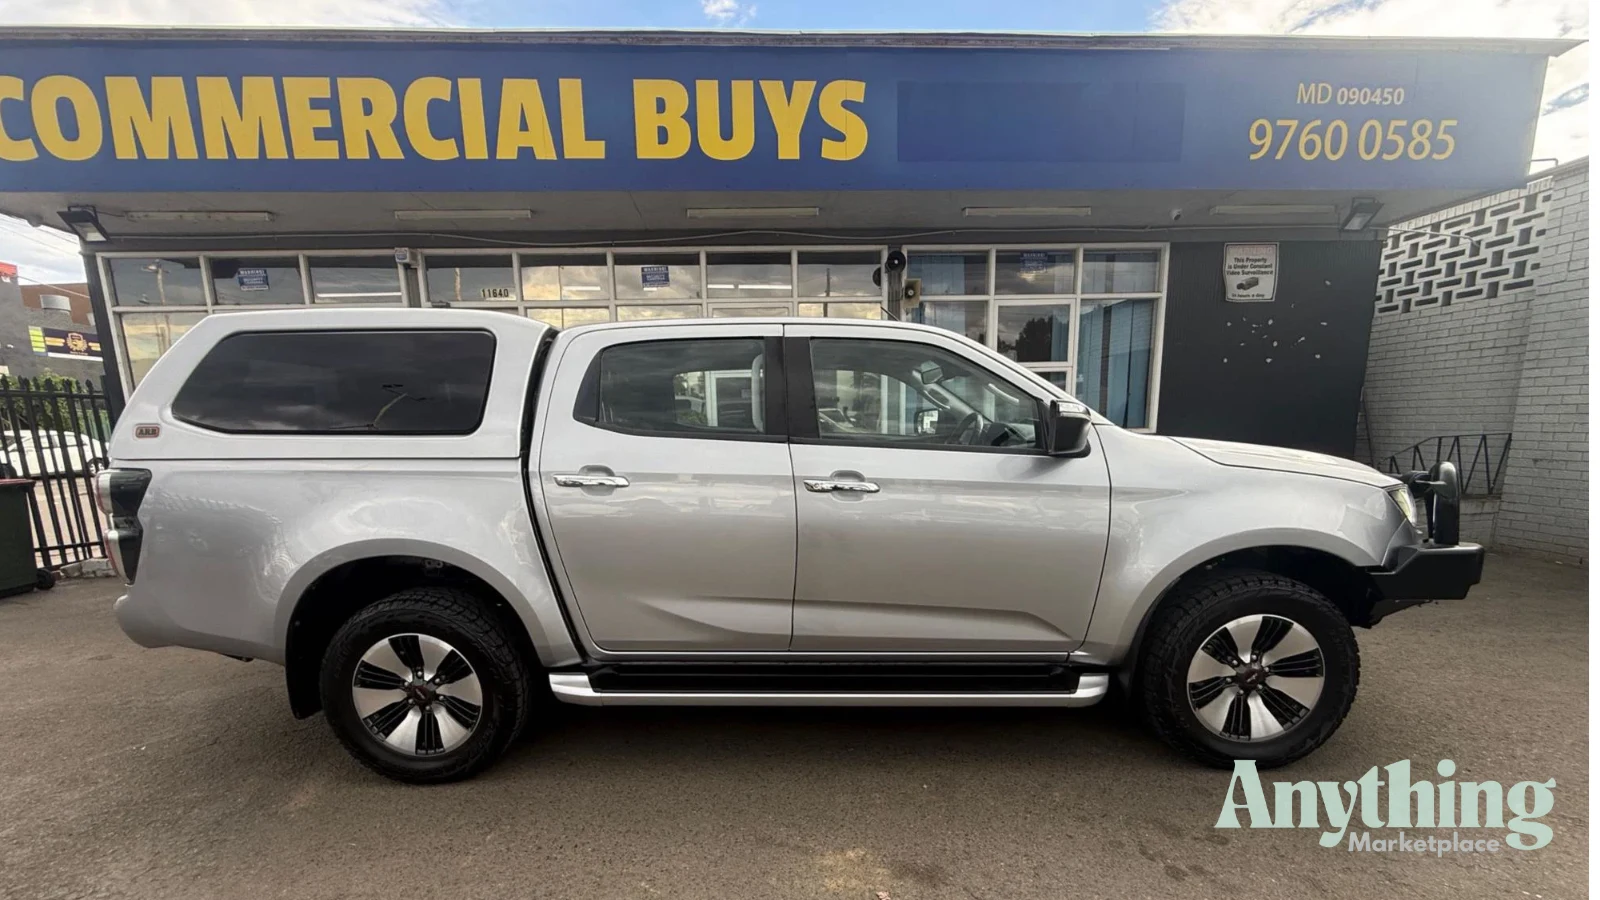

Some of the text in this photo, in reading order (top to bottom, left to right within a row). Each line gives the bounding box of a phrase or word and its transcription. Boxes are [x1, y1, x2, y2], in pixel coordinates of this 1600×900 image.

[1297, 83, 1405, 105] MD 090450
[0, 75, 868, 161] COMMERCIAL BUYS
[1249, 118, 1458, 161] 9760 0585
[481, 288, 509, 298] 11640
